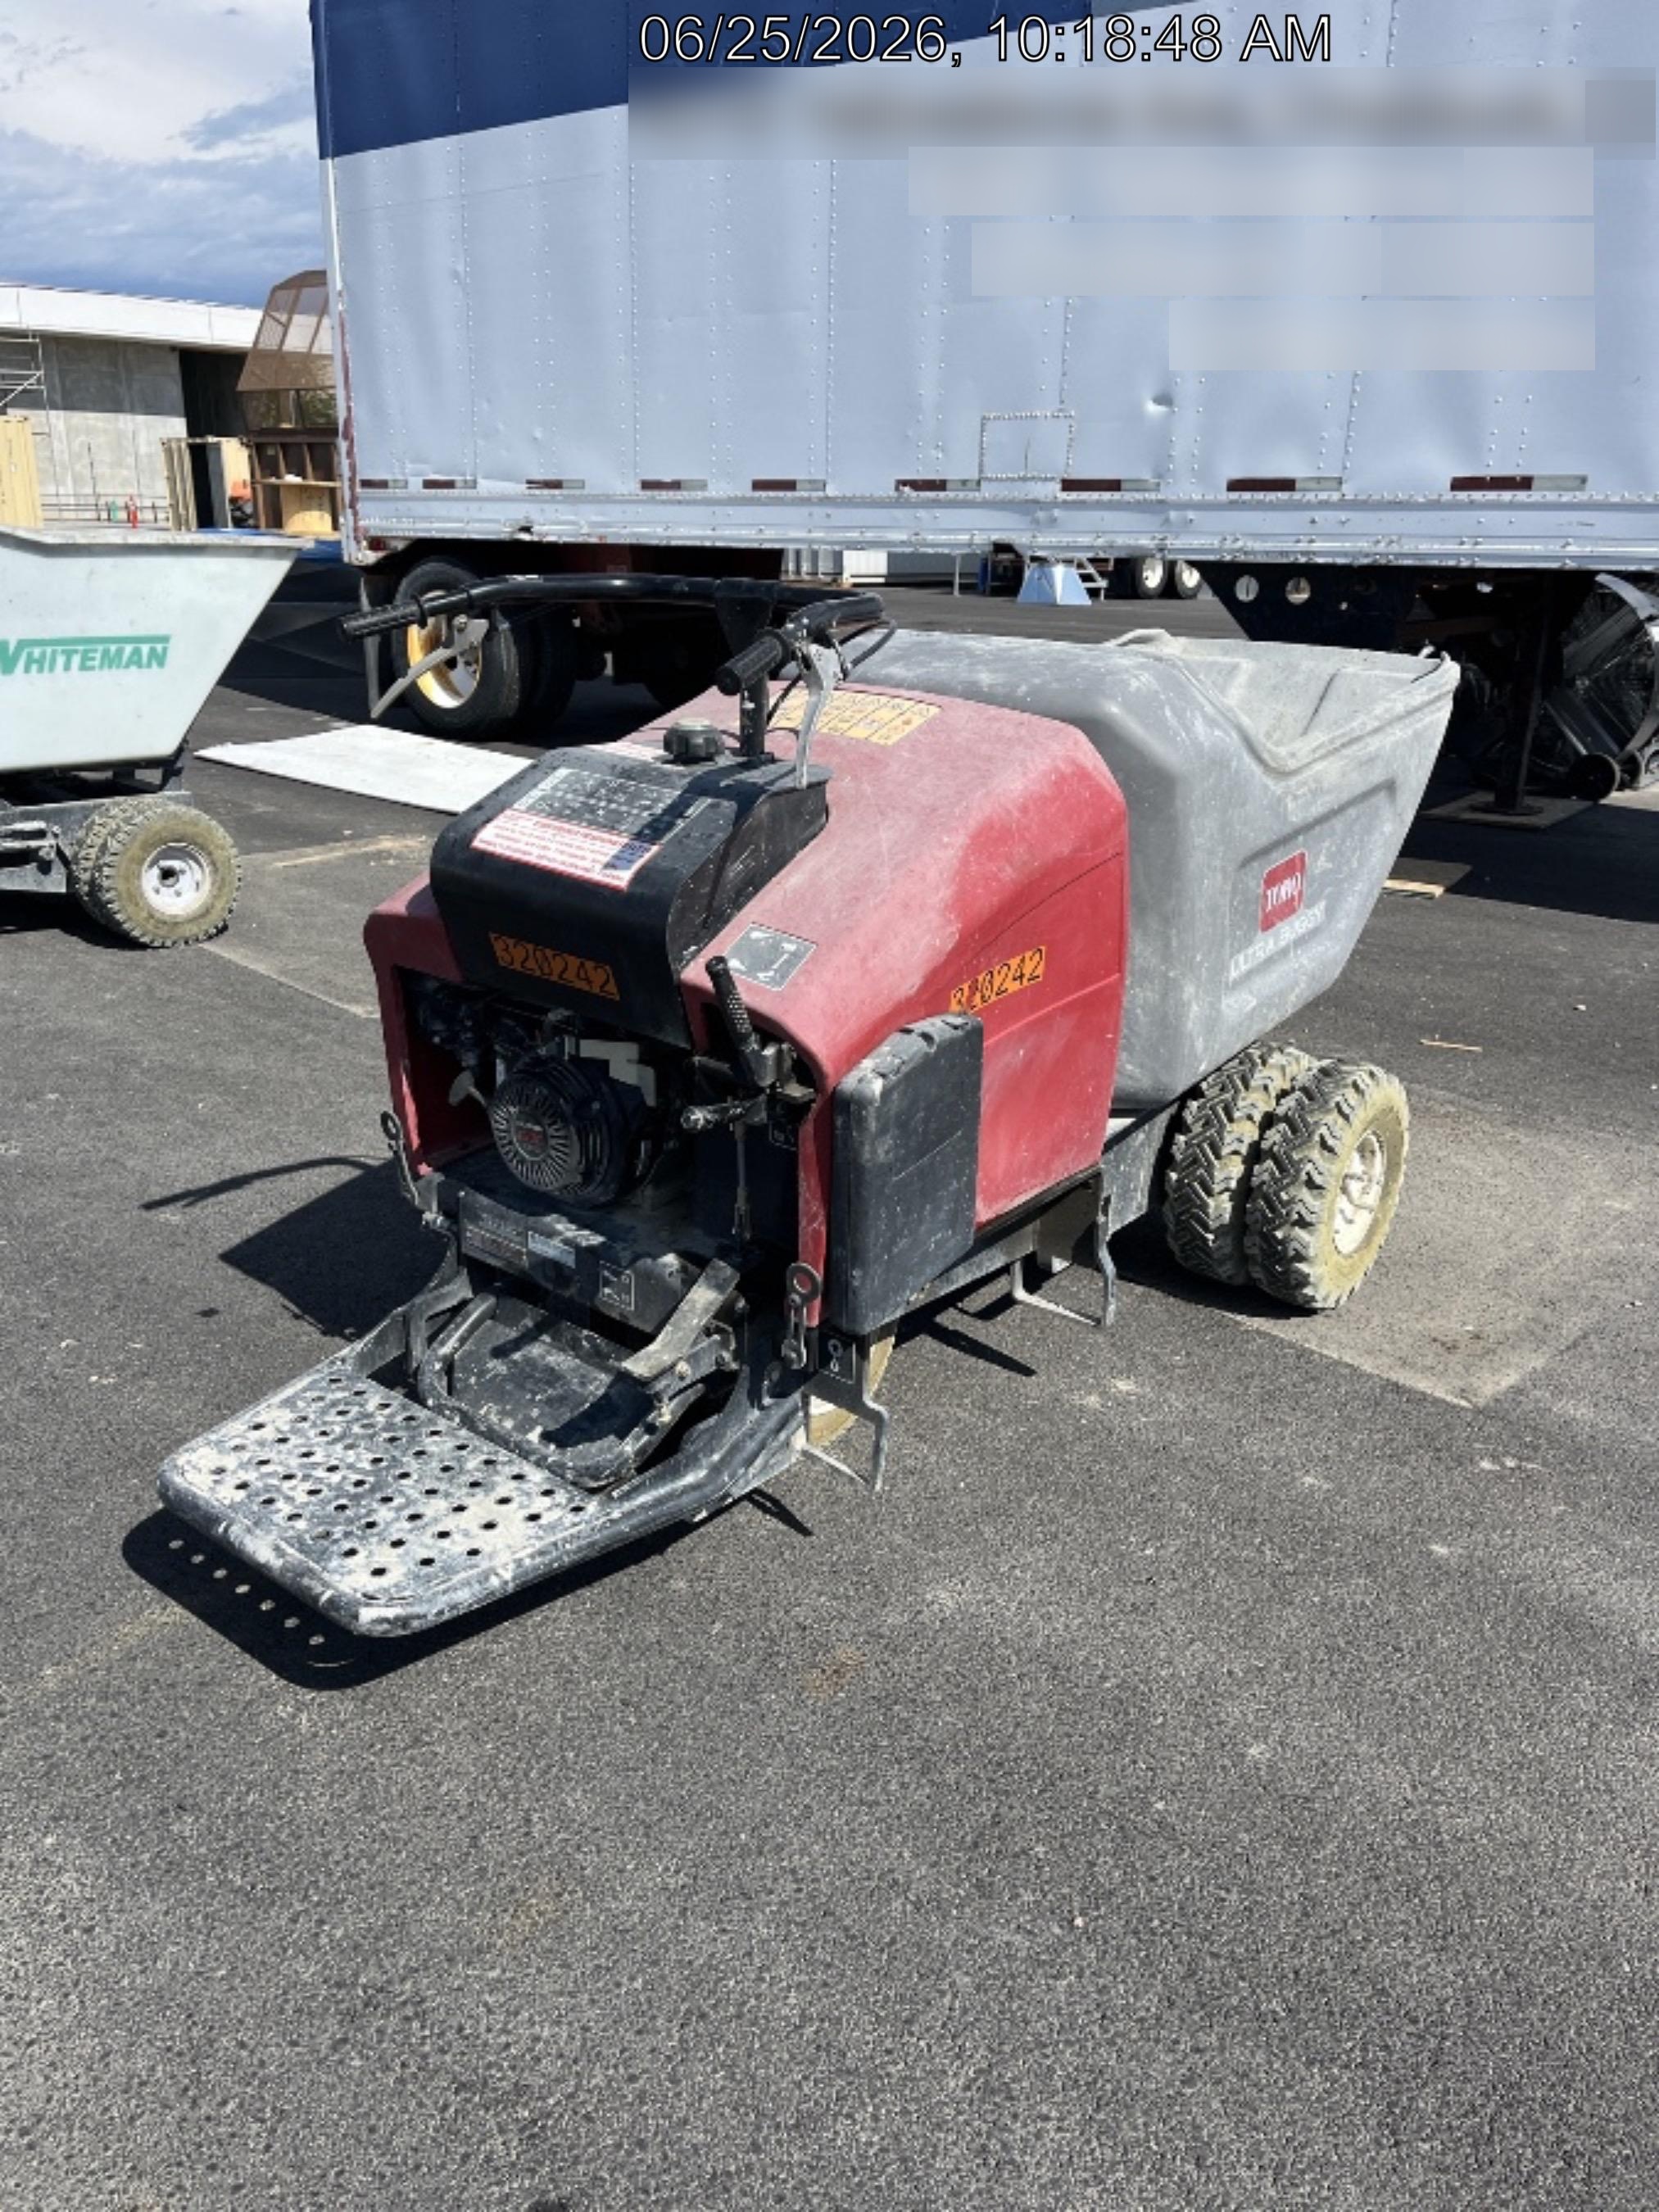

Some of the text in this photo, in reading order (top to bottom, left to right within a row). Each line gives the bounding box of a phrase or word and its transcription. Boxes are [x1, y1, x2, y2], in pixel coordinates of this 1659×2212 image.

[1265, 873, 1301, 913] TORO
[493, 936, 616, 995] 320242
[952, 947, 1043, 1014] 320242
